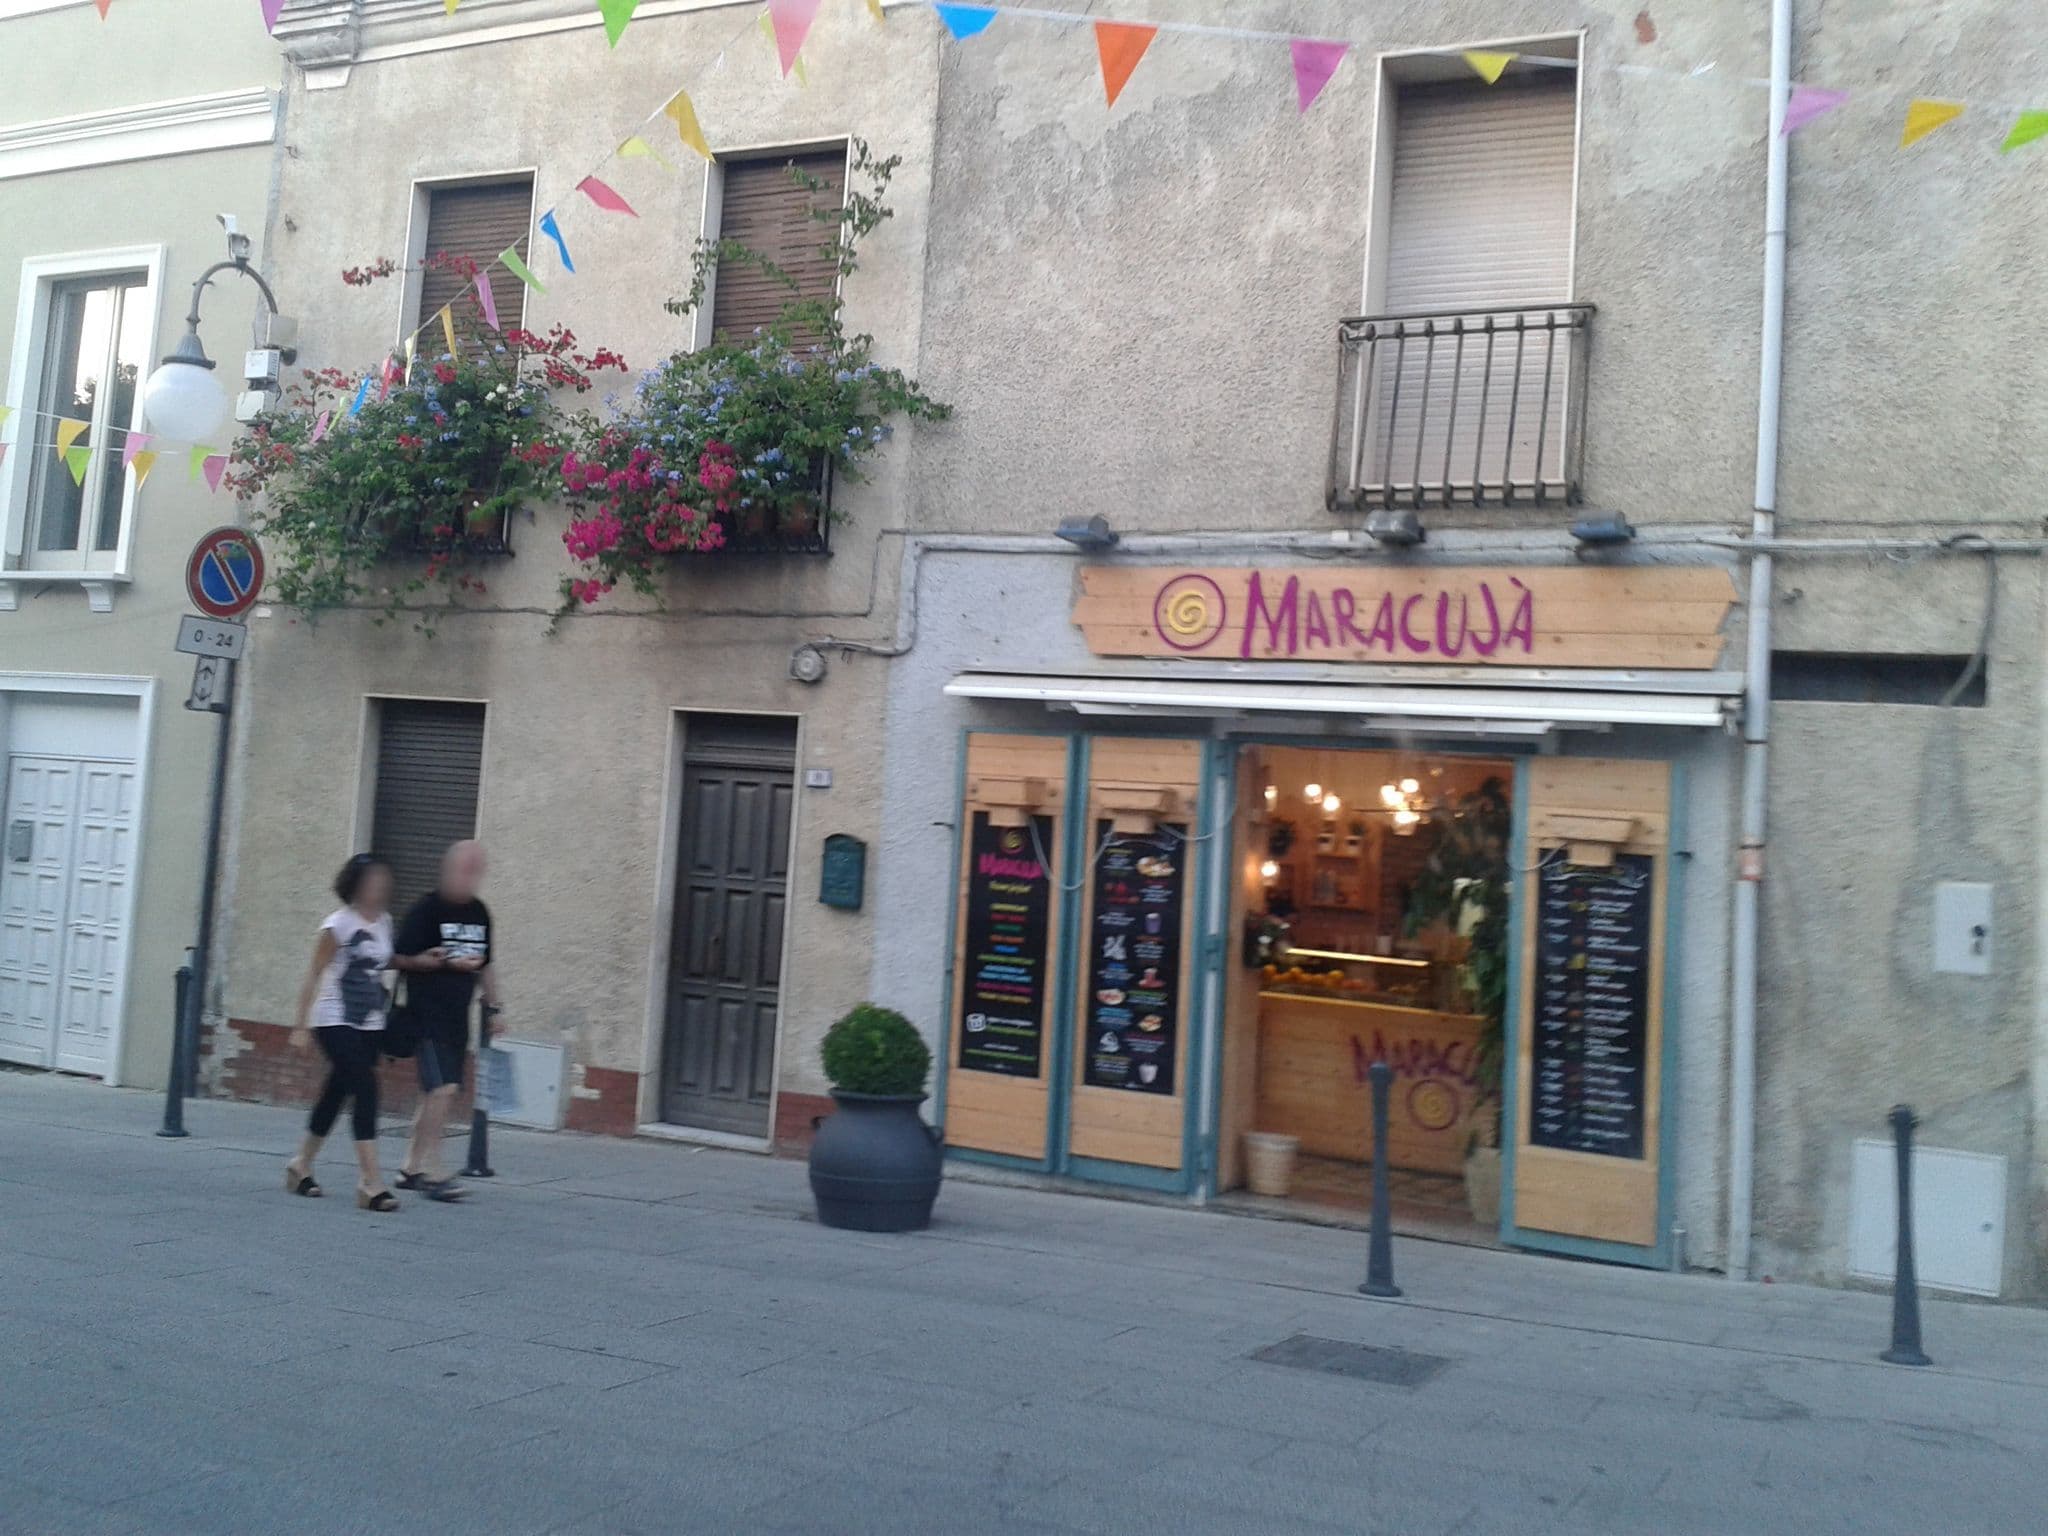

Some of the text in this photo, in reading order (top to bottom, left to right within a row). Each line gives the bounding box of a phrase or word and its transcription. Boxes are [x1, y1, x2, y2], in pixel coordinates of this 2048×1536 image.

[193, 628, 204, 643] 0
[215, 632, 234, 648] 24
[1240, 570, 1534, 659] MARACUJÀ
